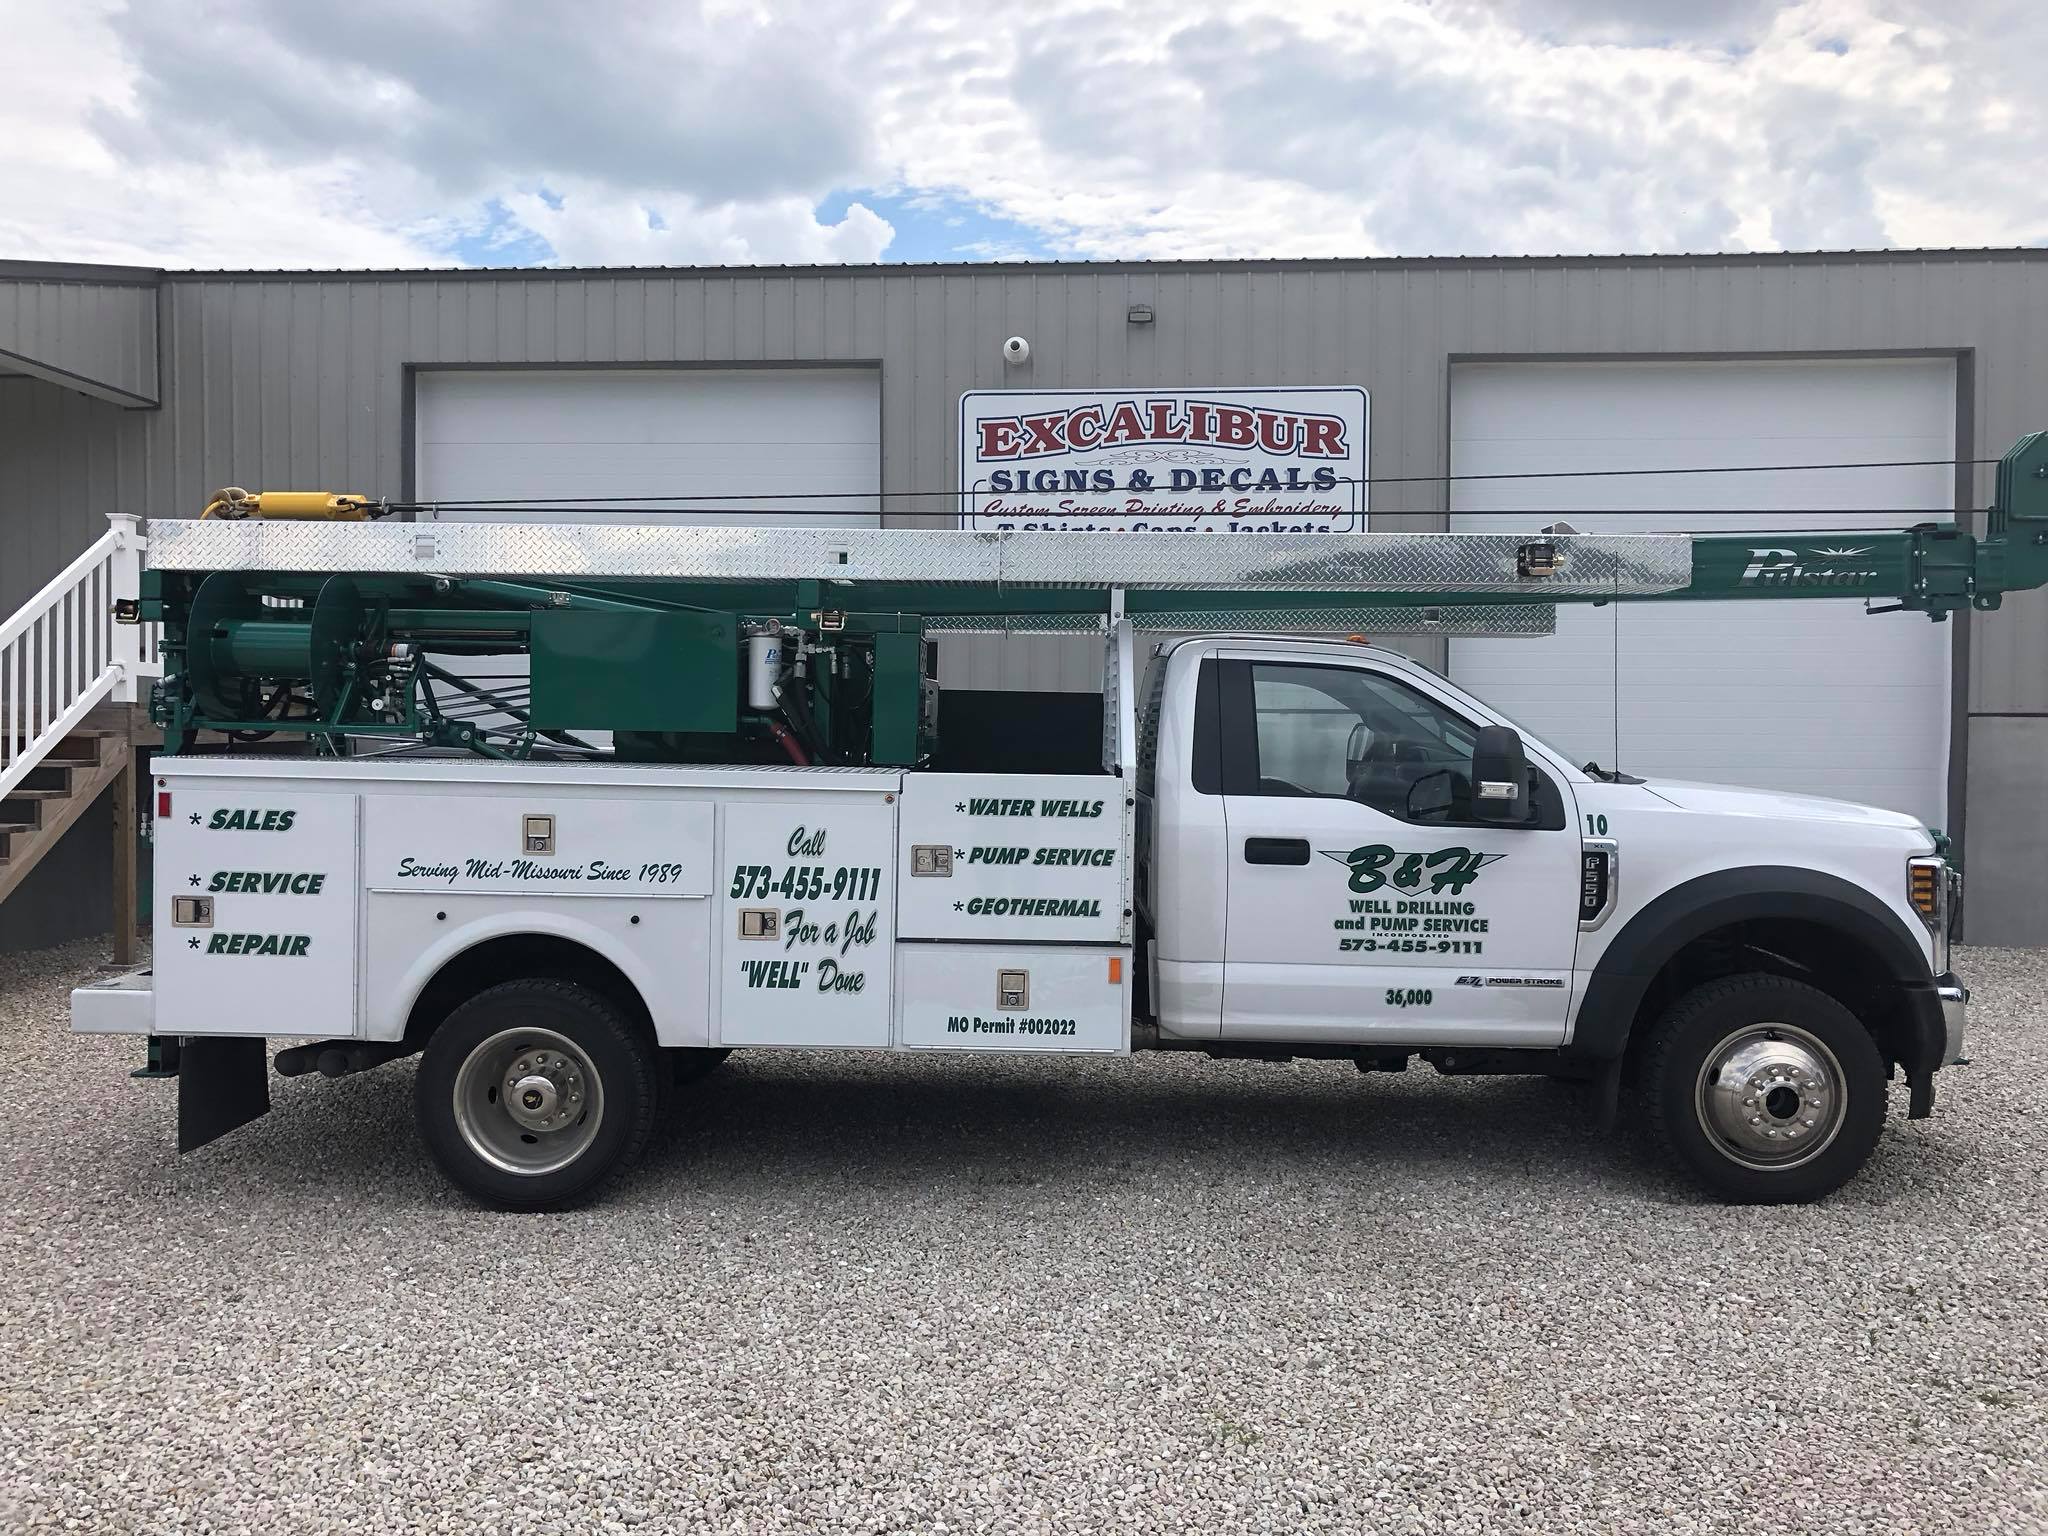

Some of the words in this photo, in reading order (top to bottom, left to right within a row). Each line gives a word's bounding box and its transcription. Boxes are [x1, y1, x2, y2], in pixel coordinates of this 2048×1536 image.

[978, 400, 1349, 461] EXCALIBUR
[990, 468, 1116, 494] SIGNS
[1128, 468, 1156, 493] &
[1170, 466, 1338, 493] DECALS
[983, 499, 1050, 517] Custom
[1058, 499, 1118, 517] Screen
[1124, 498, 1206, 522] Printing
[1211, 500, 1227, 513] &
[1231, 498, 1343, 520] Embroidery
[1738, 548, 1878, 588] Pulstar
[208, 808, 297, 831] SALES
[968, 799, 1034, 817] WATER
[1041, 800, 1104, 818] WELLS
[1586, 814, 1608, 835] 10
[787, 826, 827, 857] Call
[968, 847, 1029, 865] PUMP
[1033, 849, 1116, 867] SERVICE
[397, 857, 460, 884] Serving
[466, 859, 584, 881] Mid-Missouri
[586, 861, 632, 881] Since
[638, 863, 683, 883] 1989
[1347, 844, 1484, 896] B&H
[208, 871, 327, 895] SERVICE
[730, 865, 881, 901] 573-455-9111
[1584, 857, 1600, 907] F550
[967, 898, 1103, 917] GEOTHERMAL
[1349, 900, 1391, 914] WELL
[1396, 901, 1475, 915] DRILLING
[785, 909, 820, 949] For
[824, 922, 838, 944] a
[841, 911, 877, 954] Job
[1334, 917, 1365, 930] and
[1370, 917, 1419, 932] PUMP
[1423, 918, 1489, 933] SERVICE
[206, 933, 312, 956] REPAIR
[1339, 939, 1483, 954] 573-455-9111
[741, 961, 809, 988] "WELL"
[817, 959, 865, 992] Done
[1489, 977, 1522, 985] POWER
[1386, 989, 1432, 1007] 36,000
[947, 1017, 969, 1033] MO
[973, 1017, 1015, 1034] Permit
[1018, 1018, 1076, 1035] #002022
